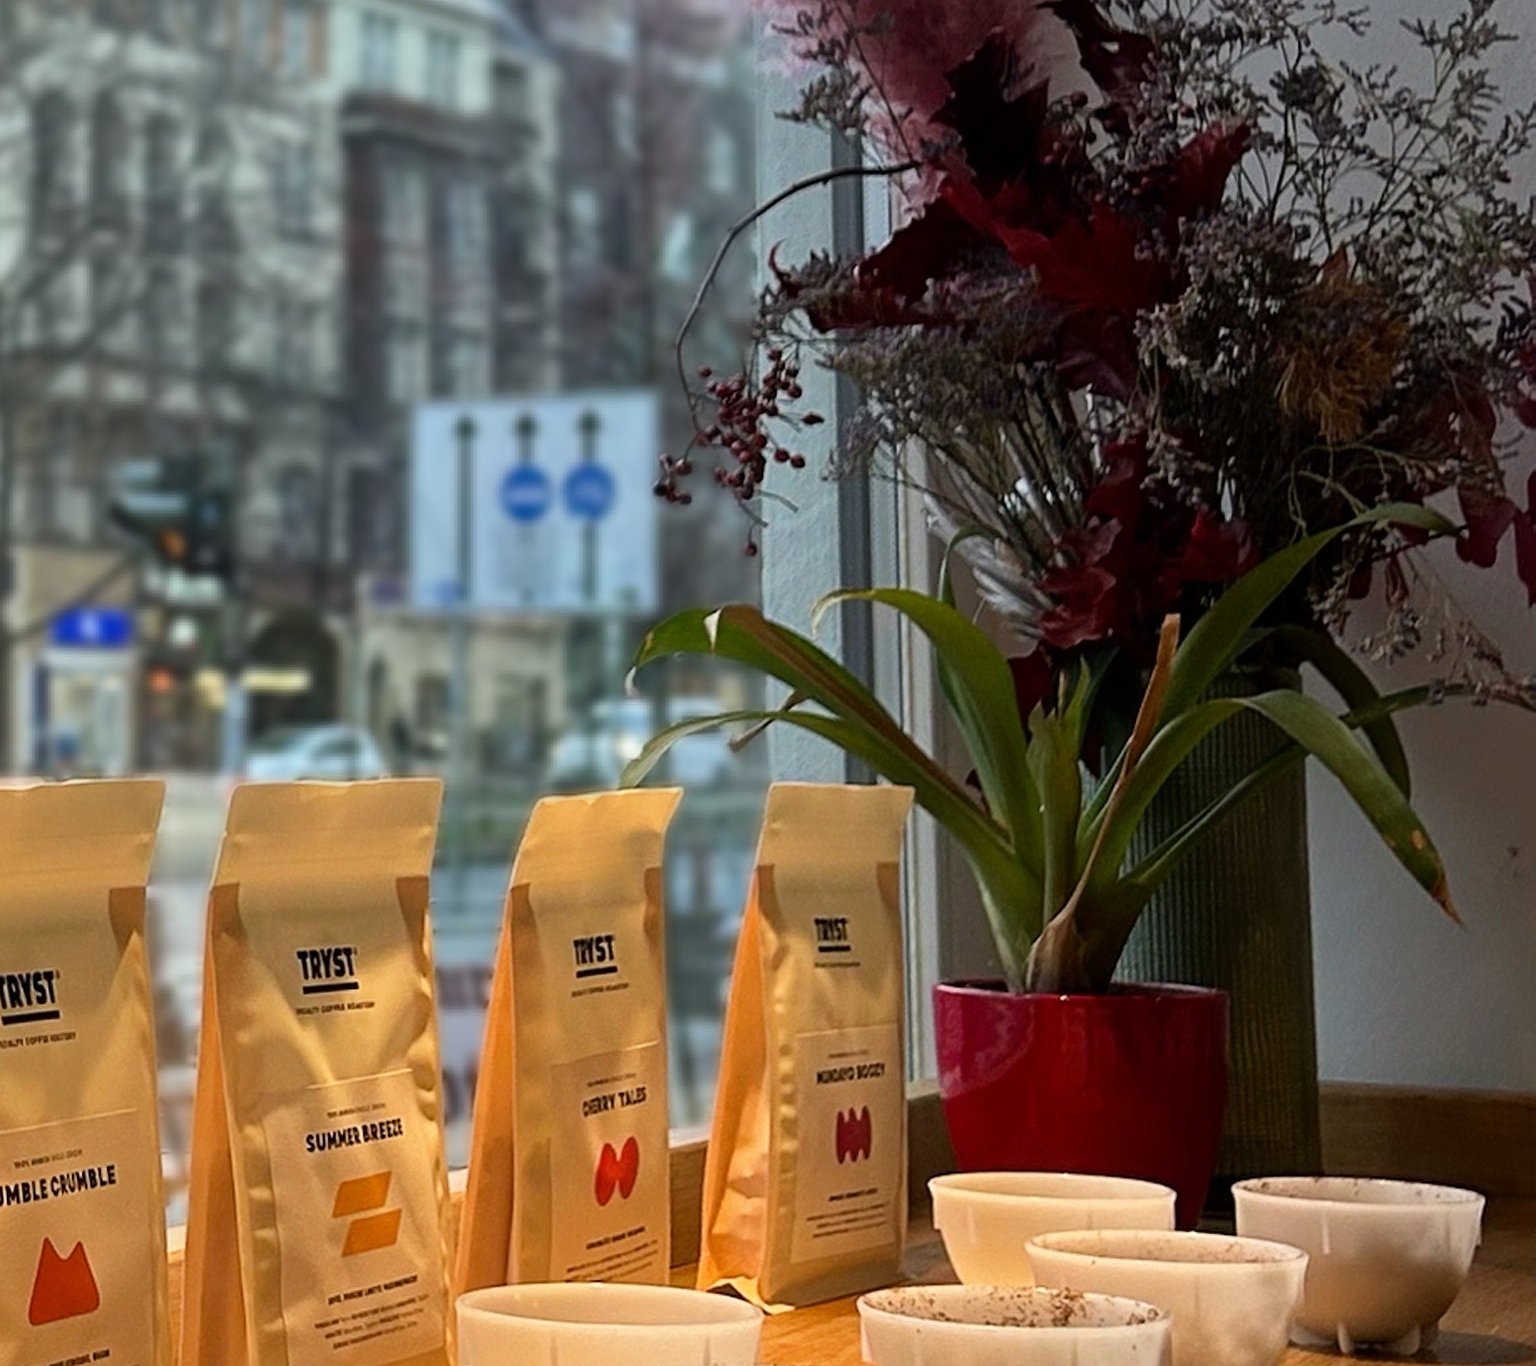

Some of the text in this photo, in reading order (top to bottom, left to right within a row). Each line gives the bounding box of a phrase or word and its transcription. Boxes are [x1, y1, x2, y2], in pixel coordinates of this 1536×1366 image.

[814, 917, 849, 942] TRYST
[296, 947, 355, 980] TRYST
[573, 934, 615, 966] TRYST
[582, 1086, 647, 1117] CHERRY TALES
[305, 1118, 403, 1152] SUMMER BREEZE
[50, 1164, 116, 1197] CRUMBLE
